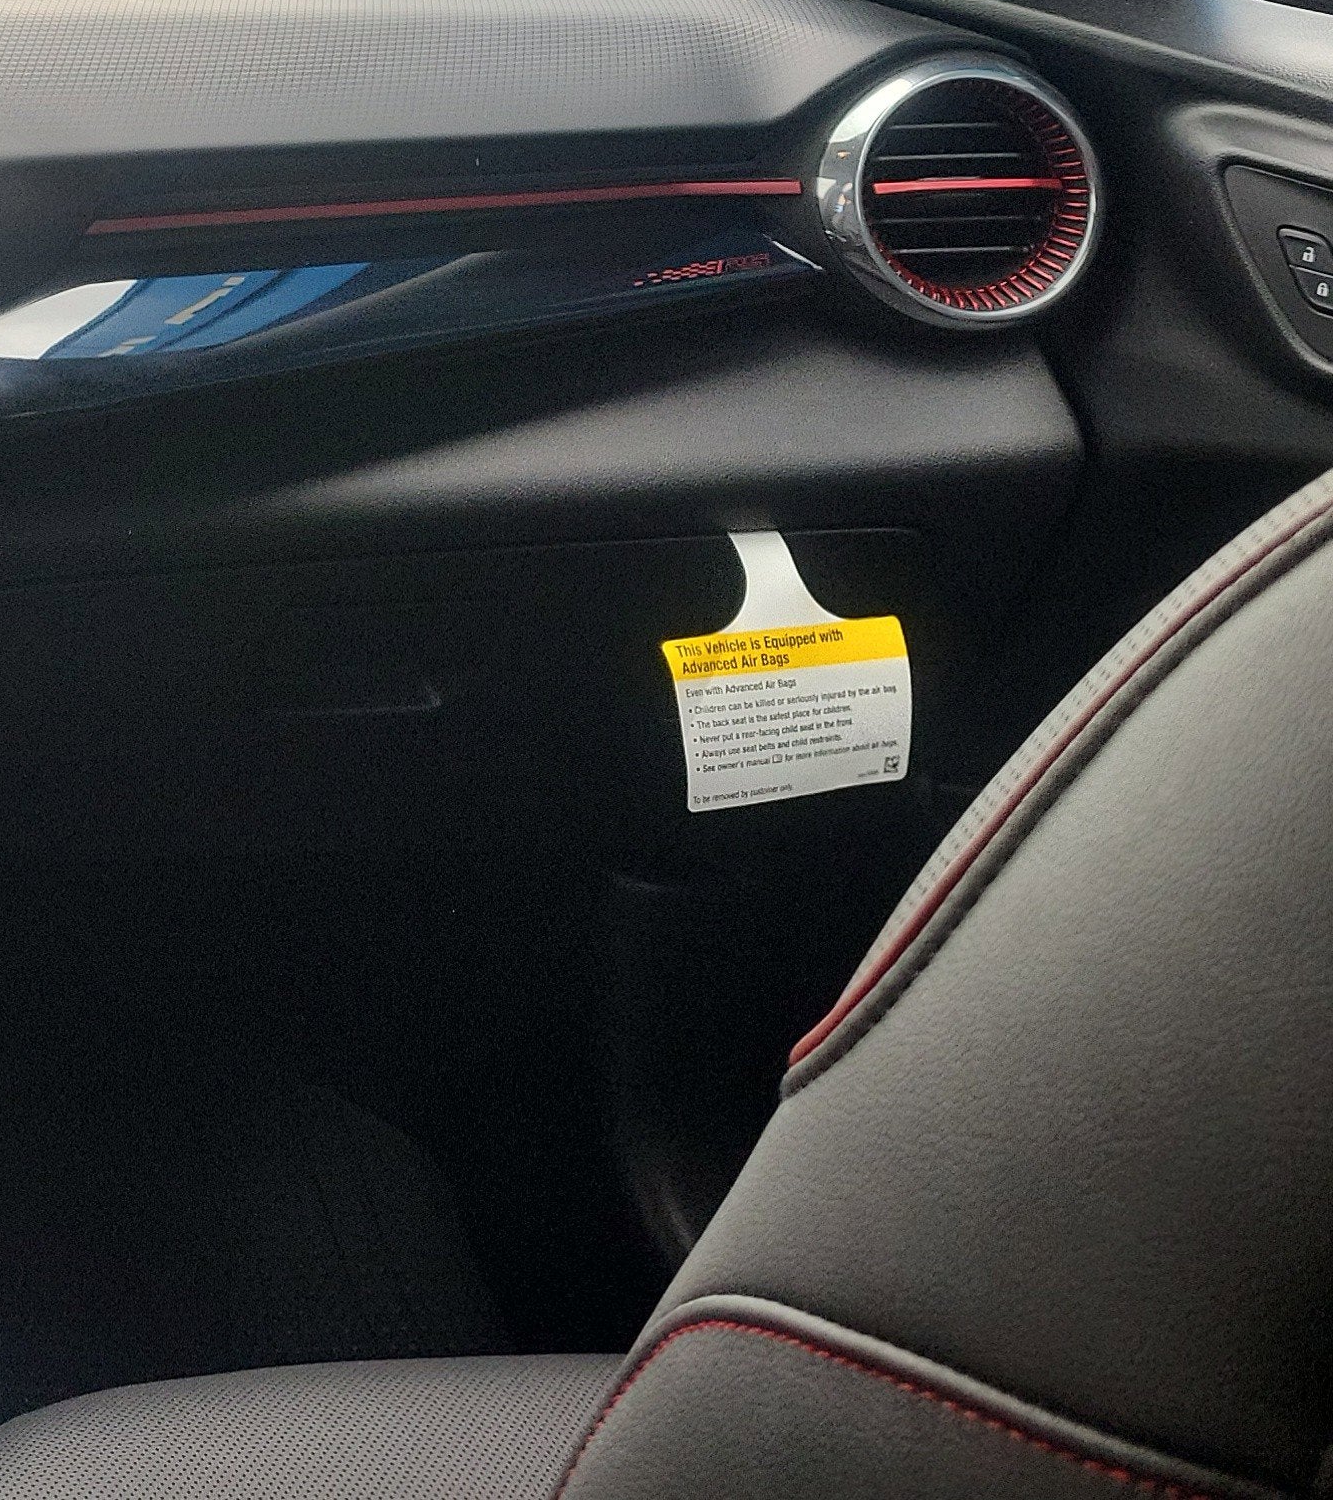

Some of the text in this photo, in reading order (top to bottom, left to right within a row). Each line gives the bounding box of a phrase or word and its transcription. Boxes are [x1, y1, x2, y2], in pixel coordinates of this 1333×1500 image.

[676, 629, 843, 658] This Vehicle is Equipped with
[683, 653, 790, 675] Advanced Air Bags
[686, 679, 796, 697] Even with Advanced Air Bags
[695, 705, 726, 714] Children
[697, 721, 711, 729] The
[732, 717, 747, 725] seat
[700, 735, 720, 743] Never
[722, 733, 733, 742] put
[742, 728, 780, 738] rear-facing
[702, 749, 726, 758] Always
[742, 744, 757, 753] seat
[777, 740, 790, 748] and
[703, 764, 715, 773] See
[693, 795, 700, 804] To
[702, 795, 711, 804] be
[712, 791, 739, 802] removed
[741, 790, 748, 798] by
